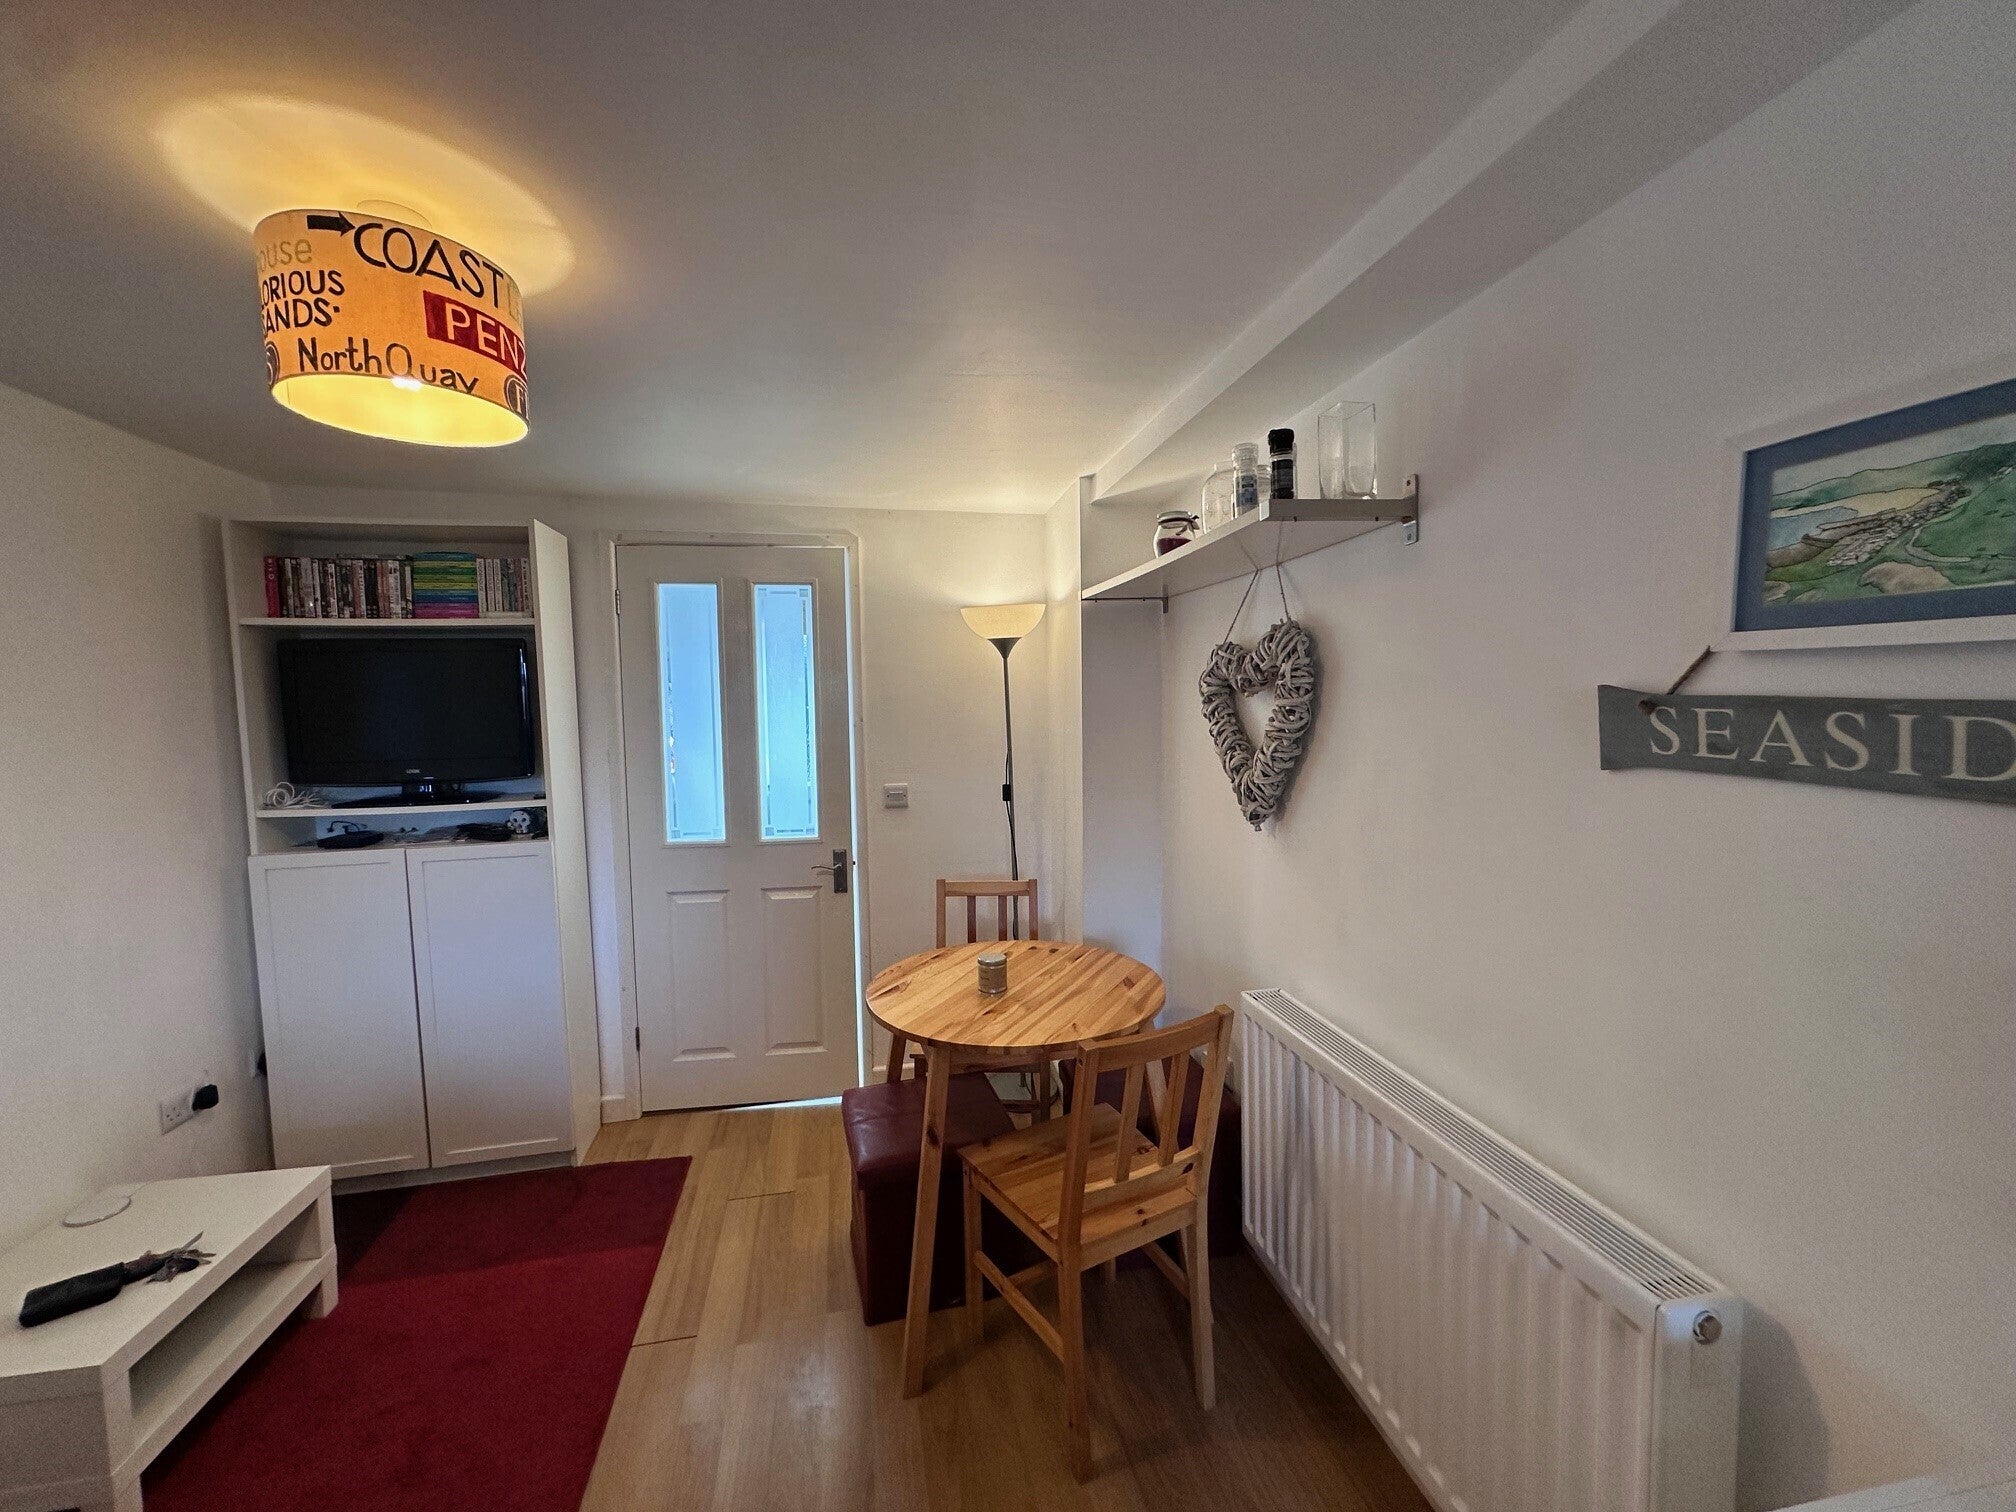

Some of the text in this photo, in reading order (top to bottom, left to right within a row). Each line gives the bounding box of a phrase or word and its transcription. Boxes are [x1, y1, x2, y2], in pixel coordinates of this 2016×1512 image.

[261, 270, 345, 311] ORIOUS
[354, 223, 504, 309] COAST
[1649, 705, 2016, 782] SEASID
